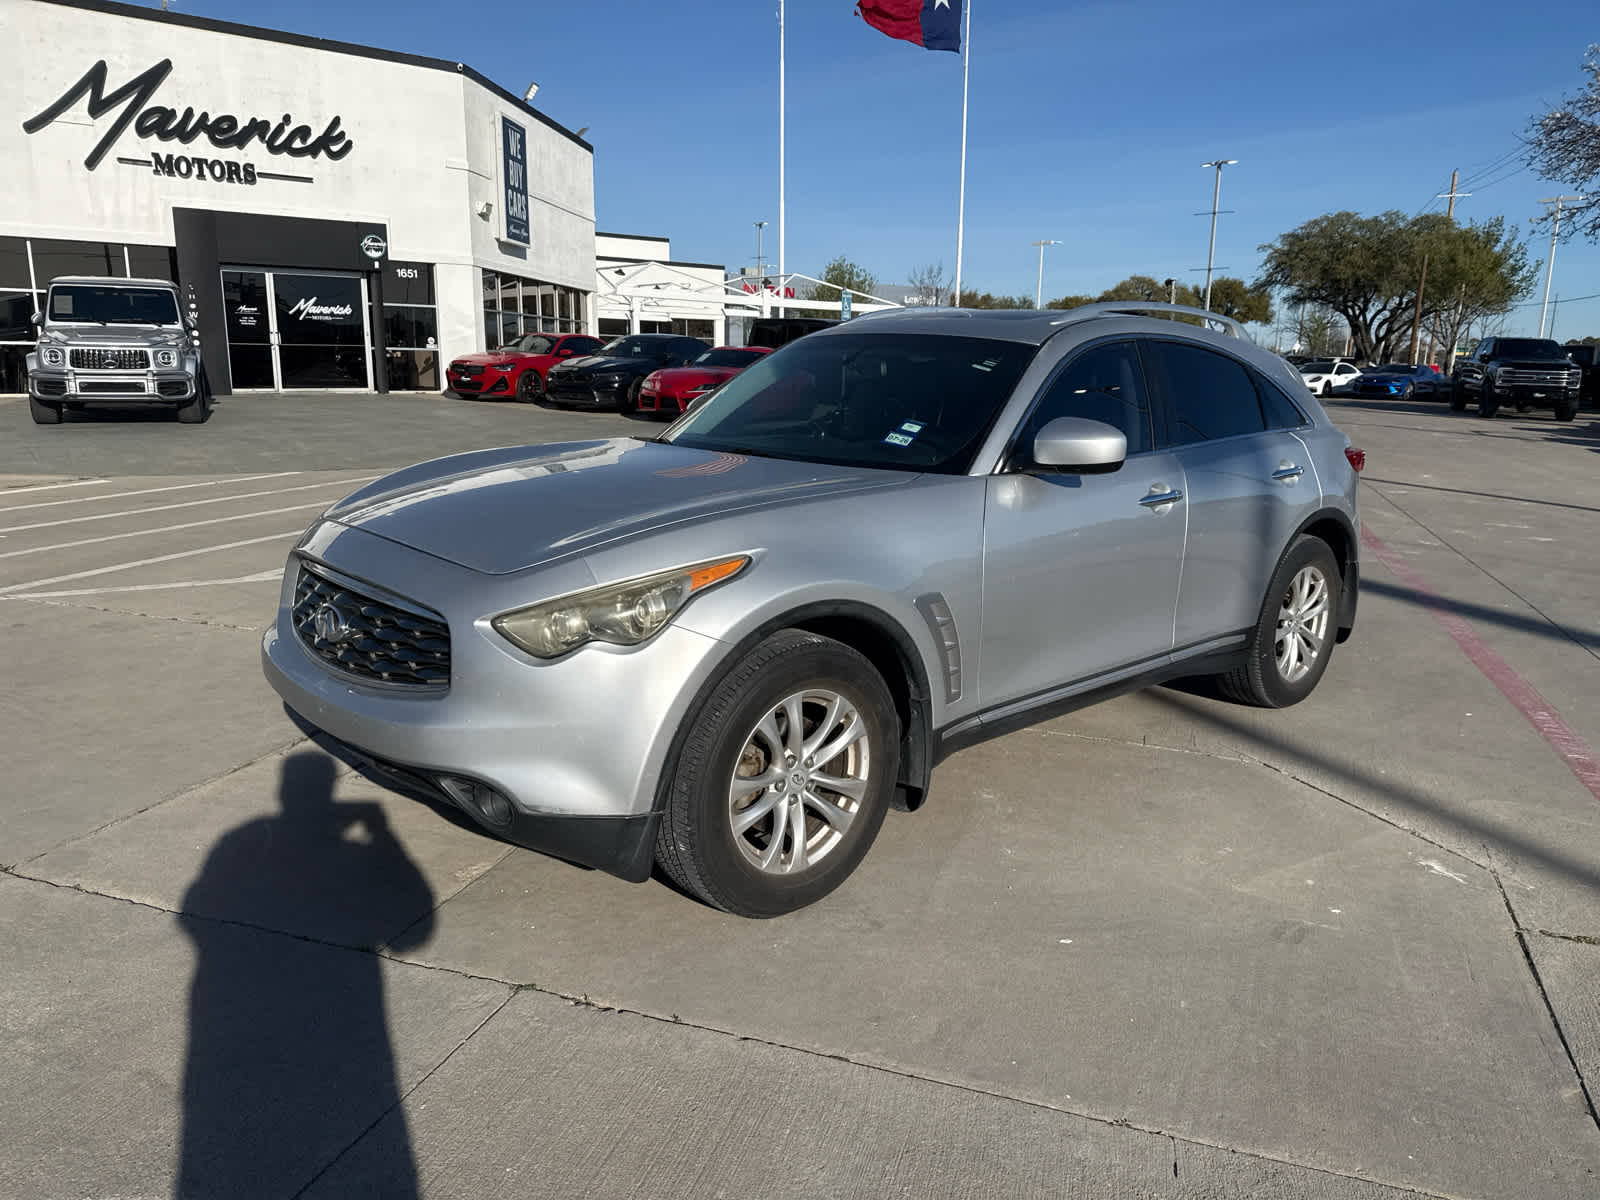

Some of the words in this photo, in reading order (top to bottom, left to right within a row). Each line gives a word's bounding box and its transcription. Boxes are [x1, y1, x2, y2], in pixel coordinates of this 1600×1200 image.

[22, 58, 353, 171] Maverick
[508, 128, 521, 159] WE
[151, 152, 257, 185] MOTORS
[509, 160, 523, 190] BUY
[508, 189, 526, 221] CARS
[396, 268, 418, 279] 1651
[288, 296, 353, 320] Maverick
